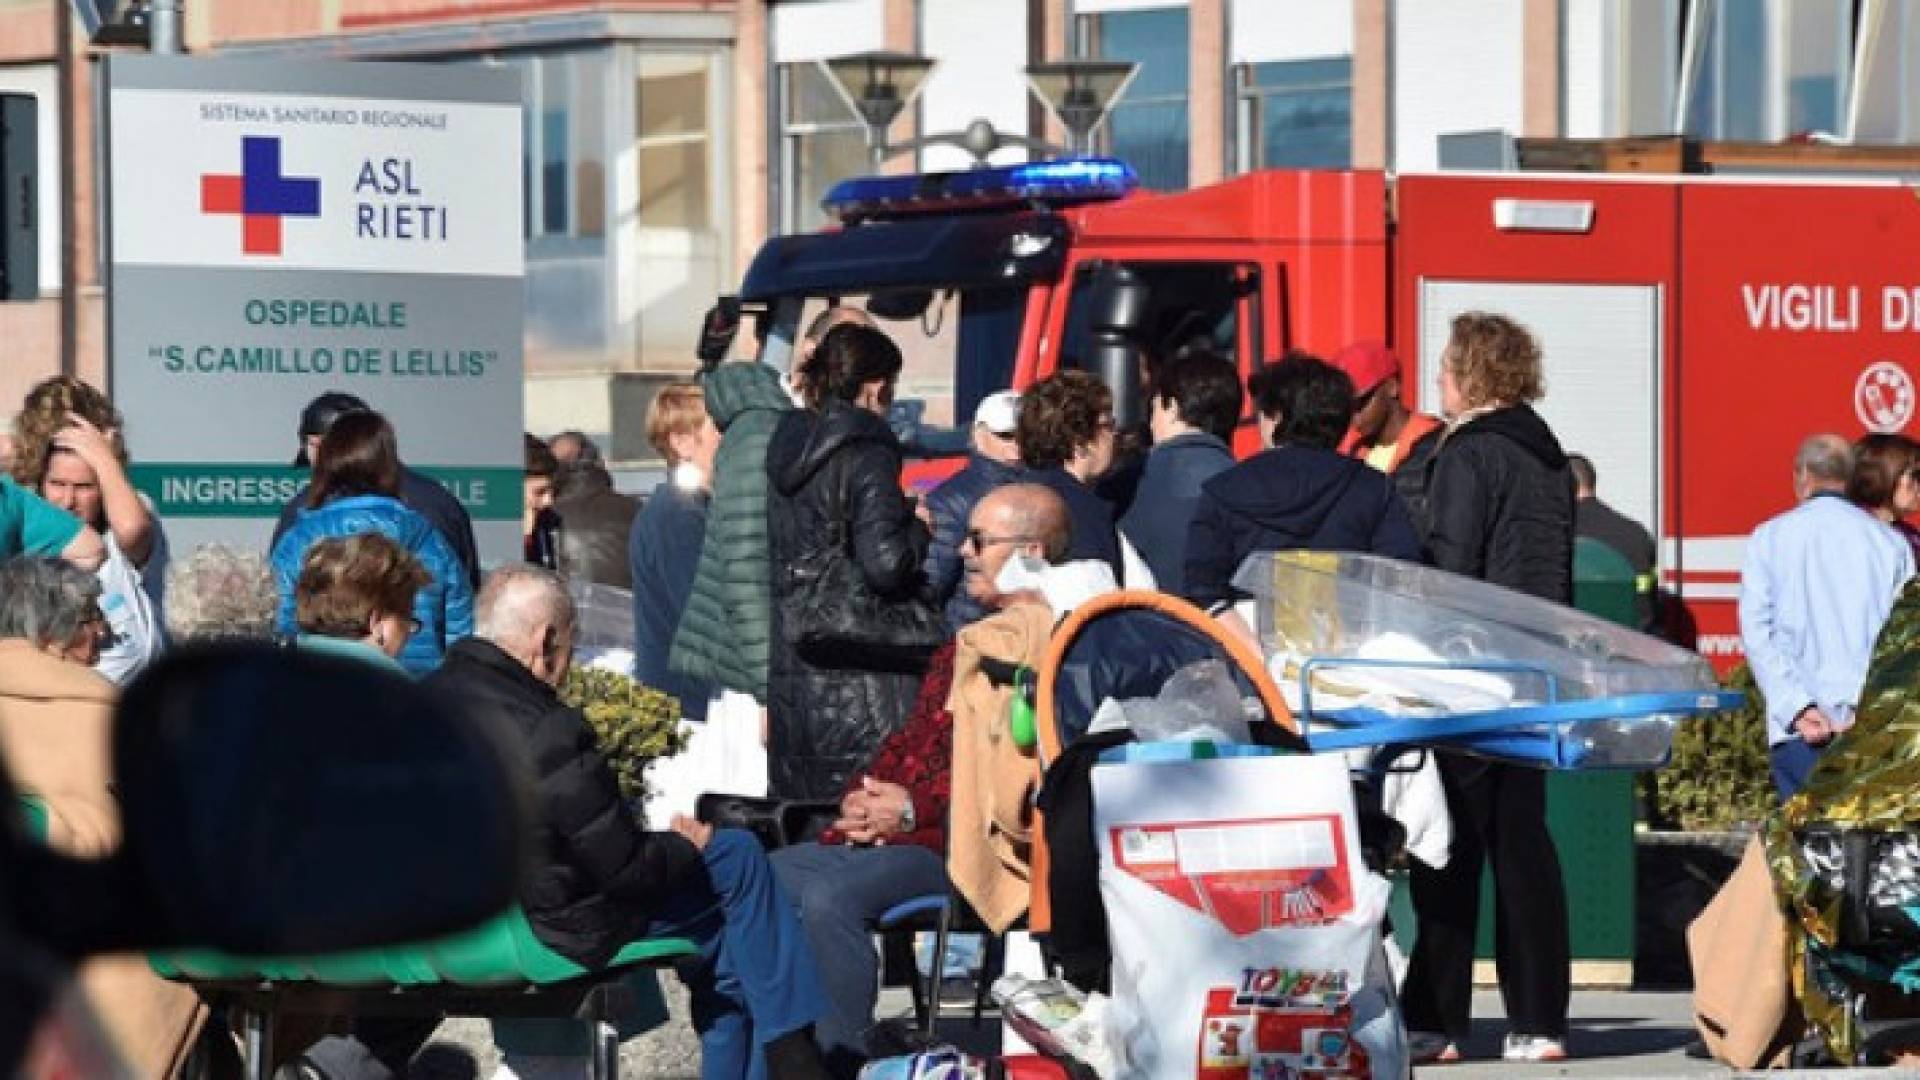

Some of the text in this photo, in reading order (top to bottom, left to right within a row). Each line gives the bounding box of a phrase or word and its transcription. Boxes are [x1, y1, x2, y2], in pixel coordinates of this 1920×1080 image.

[200, 103, 447, 130] SISTEMA SANITARIO REGIONALE
[355, 158, 422, 195] ASL
[357, 204, 448, 241] RIETI
[244, 299, 407, 328] OSPEDALE
[1742, 283, 1859, 332] VIGILI
[342, 349, 382, 374] DE
[161, 477, 310, 506] INGRESS
